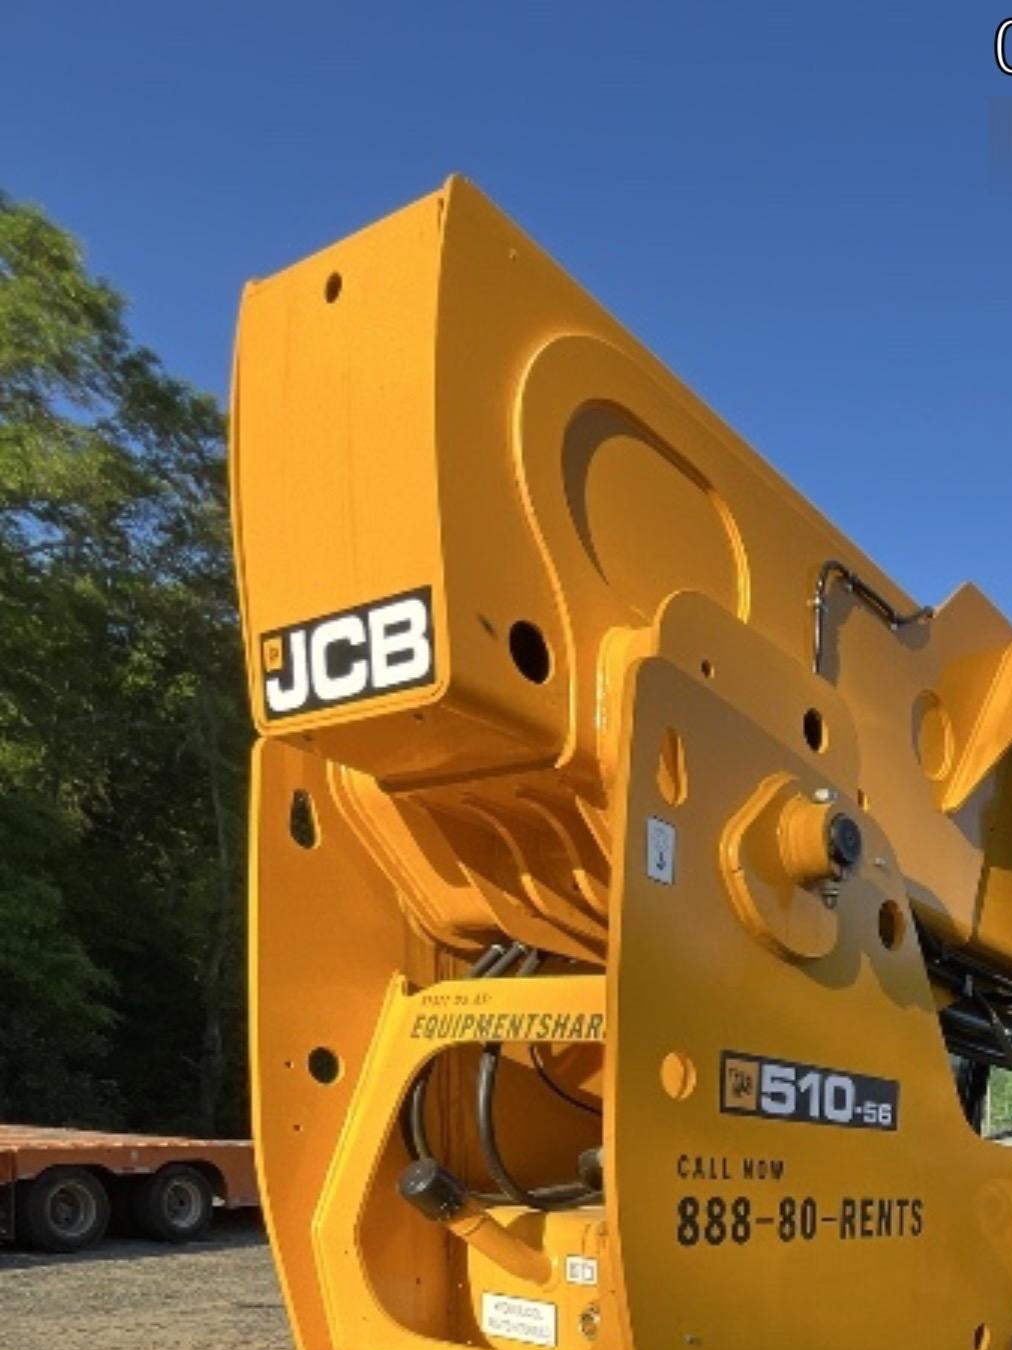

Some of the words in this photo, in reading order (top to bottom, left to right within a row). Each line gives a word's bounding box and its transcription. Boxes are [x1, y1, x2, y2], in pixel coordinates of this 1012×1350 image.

[265, 598, 431, 713] JCB
[410, 1013, 606, 1040] EQUIPMENTSHAR
[676, 1155, 731, 1180] CALL
[743, 1158, 786, 1181] NOW
[676, 1195, 925, 1246] 888-80-RENTS
